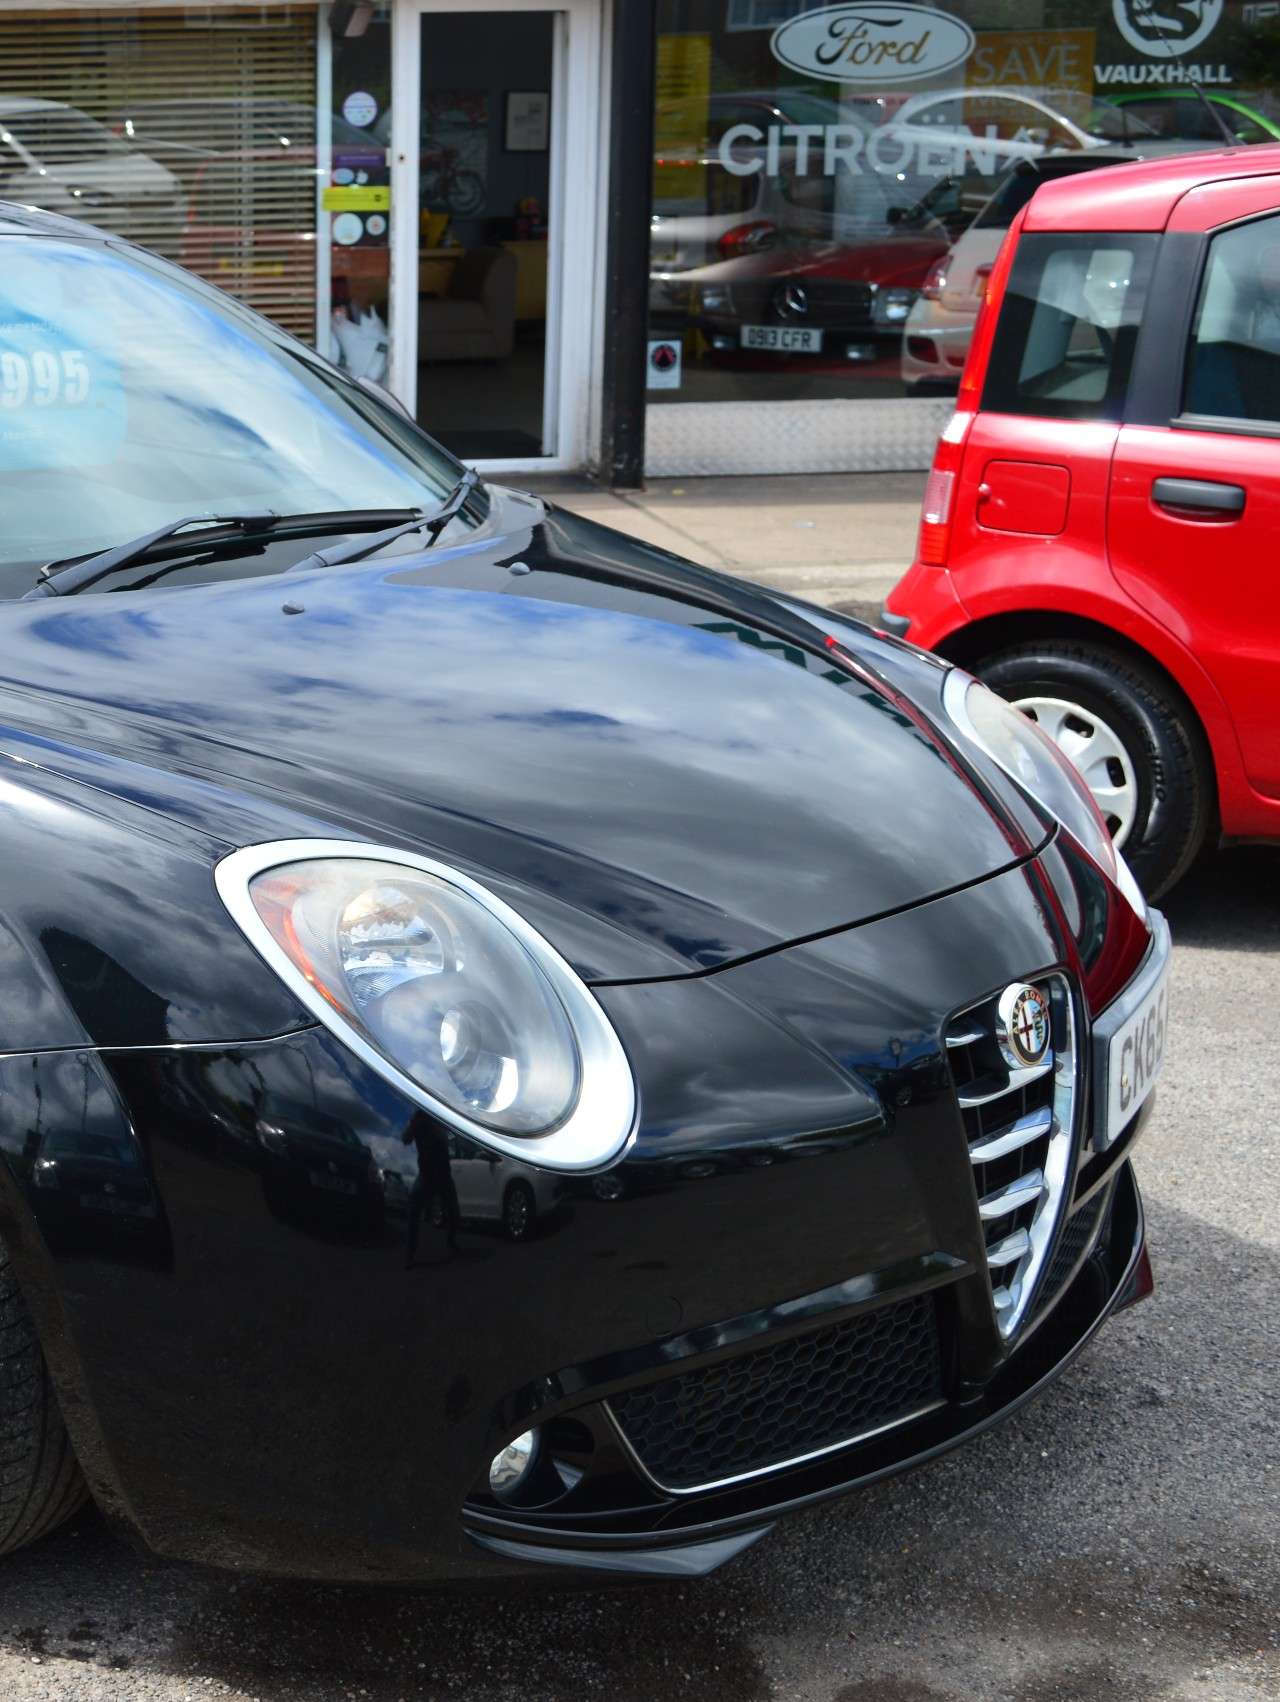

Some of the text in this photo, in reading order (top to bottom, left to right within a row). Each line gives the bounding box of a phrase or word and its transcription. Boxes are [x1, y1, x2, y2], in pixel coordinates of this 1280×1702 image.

[815, 15, 932, 66] Ford
[974, 43, 1081, 84] SAVE
[1093, 63, 1233, 84] VAUXHALL
[781, 329, 812, 349] CFR
